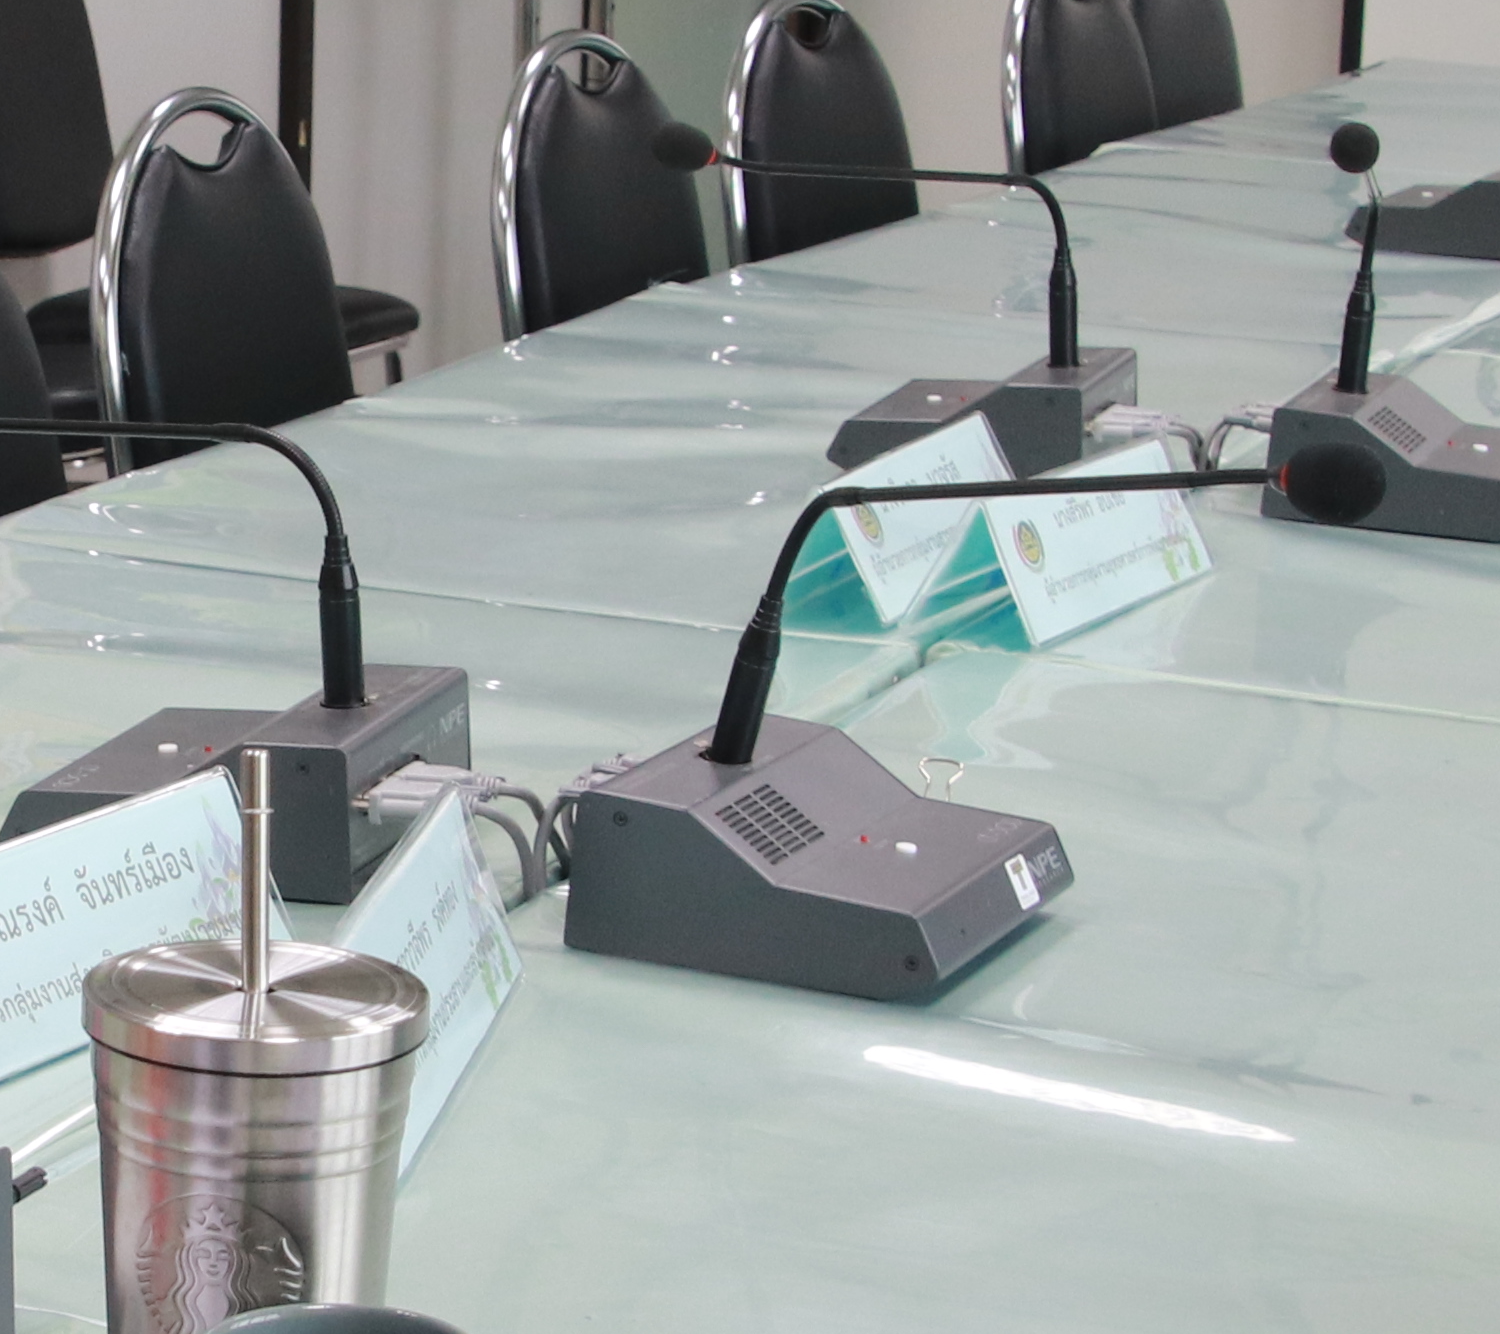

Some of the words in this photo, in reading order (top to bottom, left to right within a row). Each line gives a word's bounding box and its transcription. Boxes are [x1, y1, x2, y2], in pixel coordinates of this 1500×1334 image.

[75, 841, 195, 911] จันทร์เมือง
[1026, 846, 1061, 878] NPE
